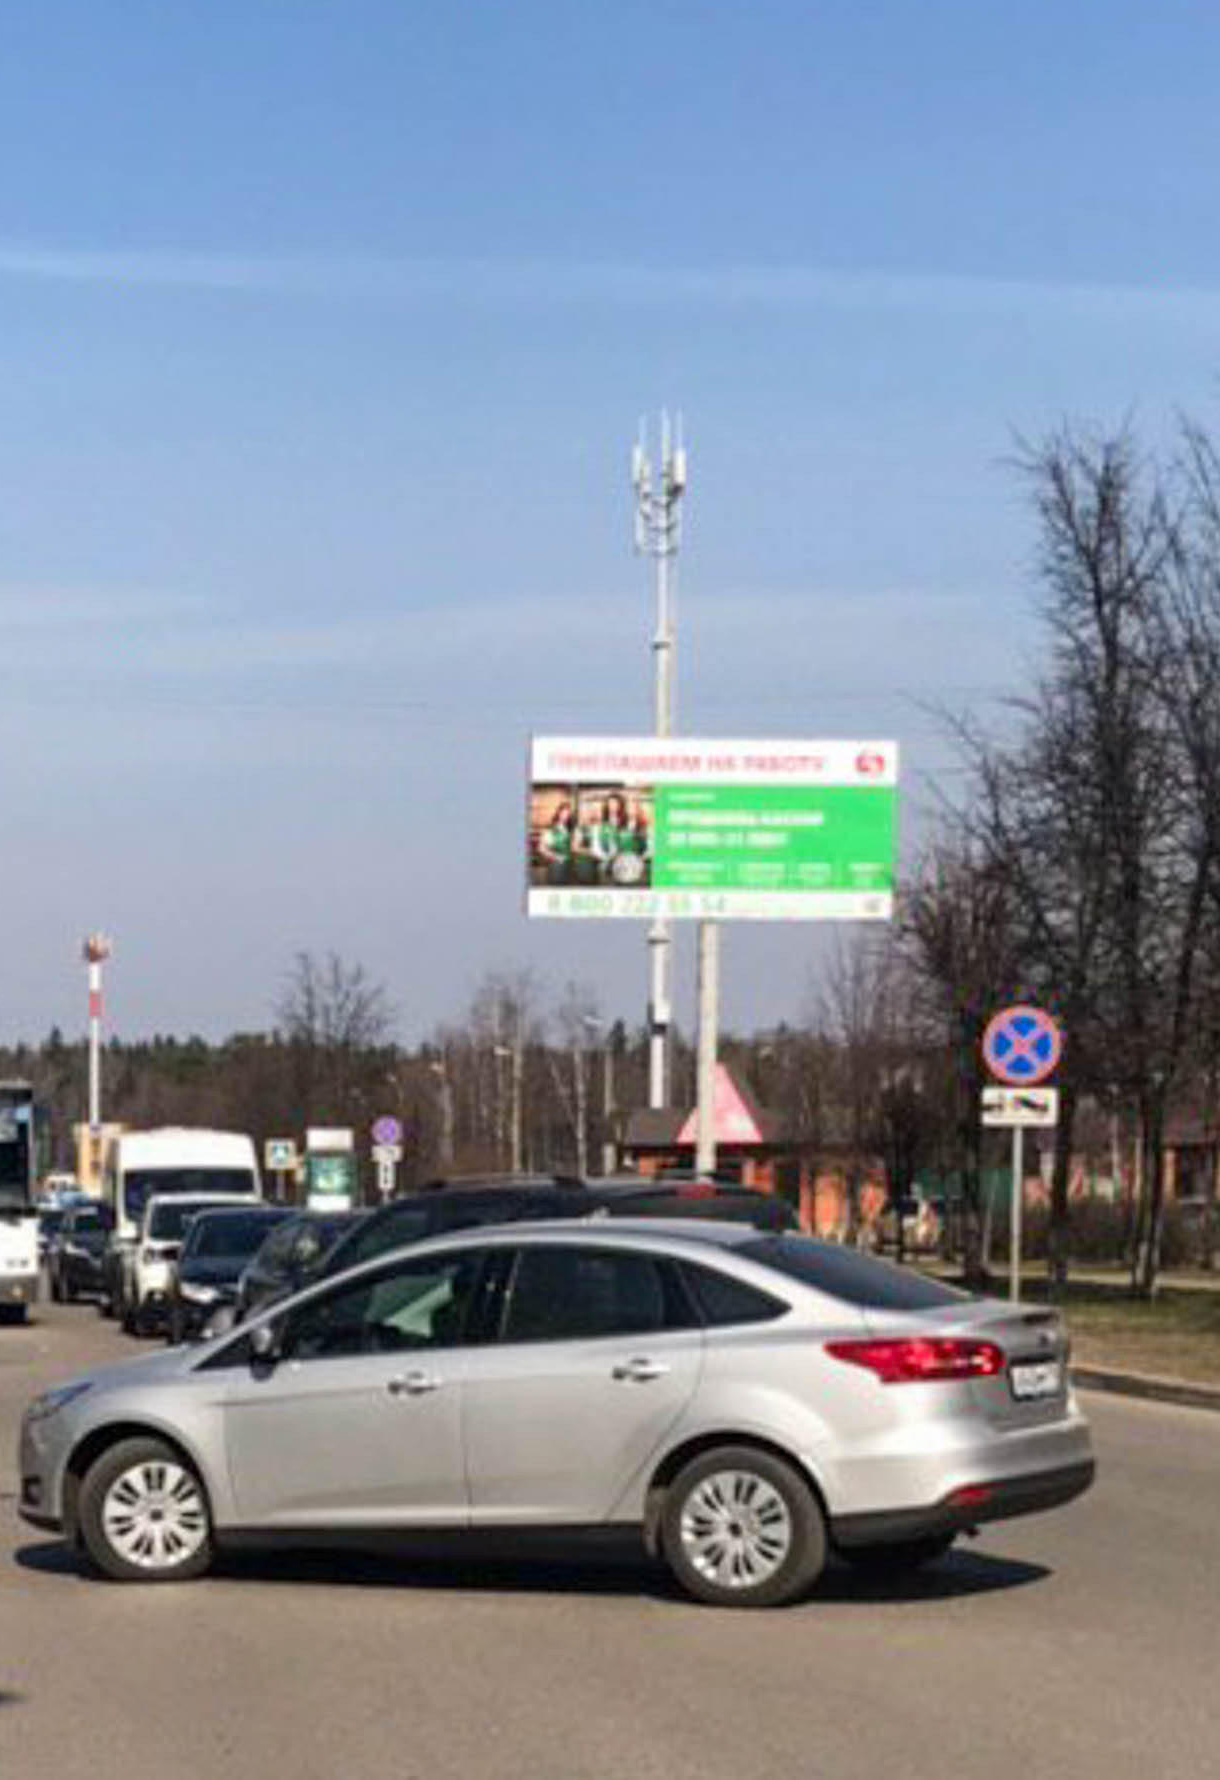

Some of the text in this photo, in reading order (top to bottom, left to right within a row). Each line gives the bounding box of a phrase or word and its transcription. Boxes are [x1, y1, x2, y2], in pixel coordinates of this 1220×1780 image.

[547, 752, 826, 773] ПРИГЛАШАЕМ НА РАБОТУ
